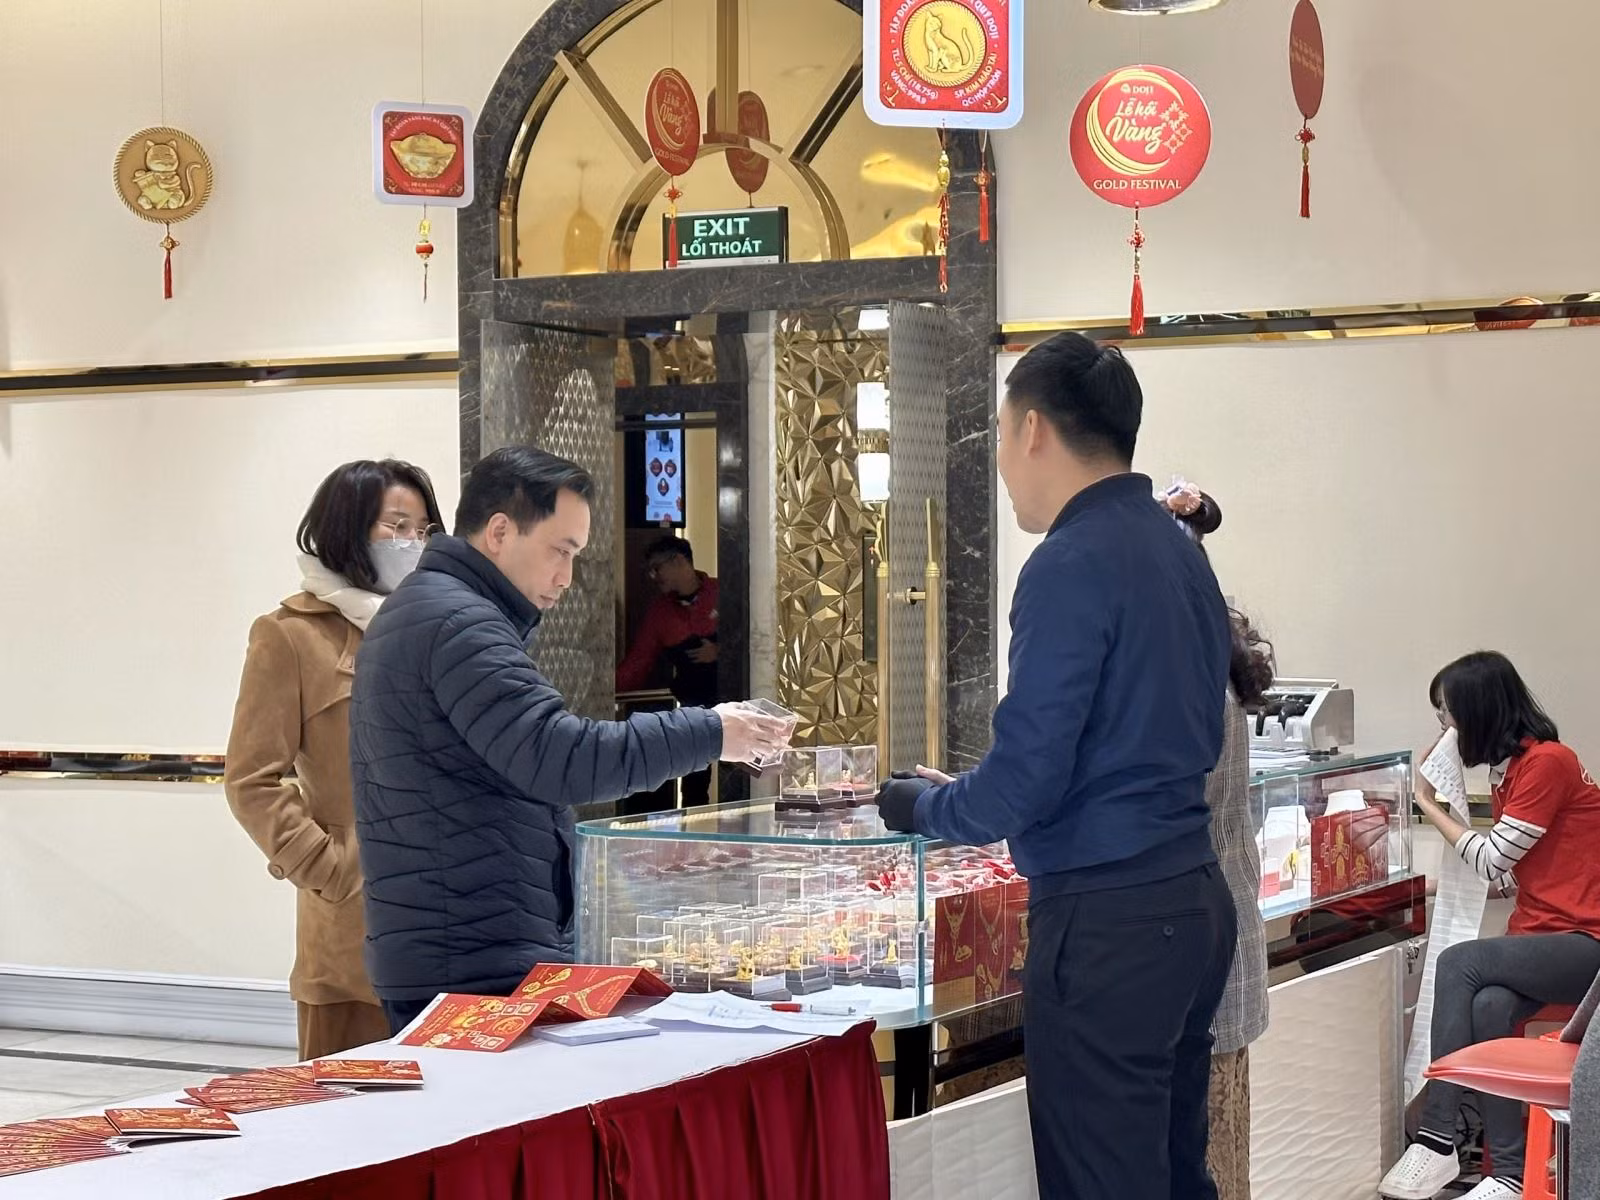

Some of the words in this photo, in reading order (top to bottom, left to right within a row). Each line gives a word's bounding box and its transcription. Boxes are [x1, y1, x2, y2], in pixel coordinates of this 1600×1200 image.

[986, 17, 999, 39] DOJI
[964, 81, 980, 94] KIM
[1115, 96, 1136, 117] Lễ
[1135, 101, 1158, 120] hội
[1105, 116, 1167, 154] Vàng
[1093, 179, 1128, 190] GOLD
[1131, 179, 1182, 190] FESTIVAL
[694, 217, 750, 237] EXIT
[682, 238, 706, 256] LỐI
[709, 238, 762, 255] THOÁT
